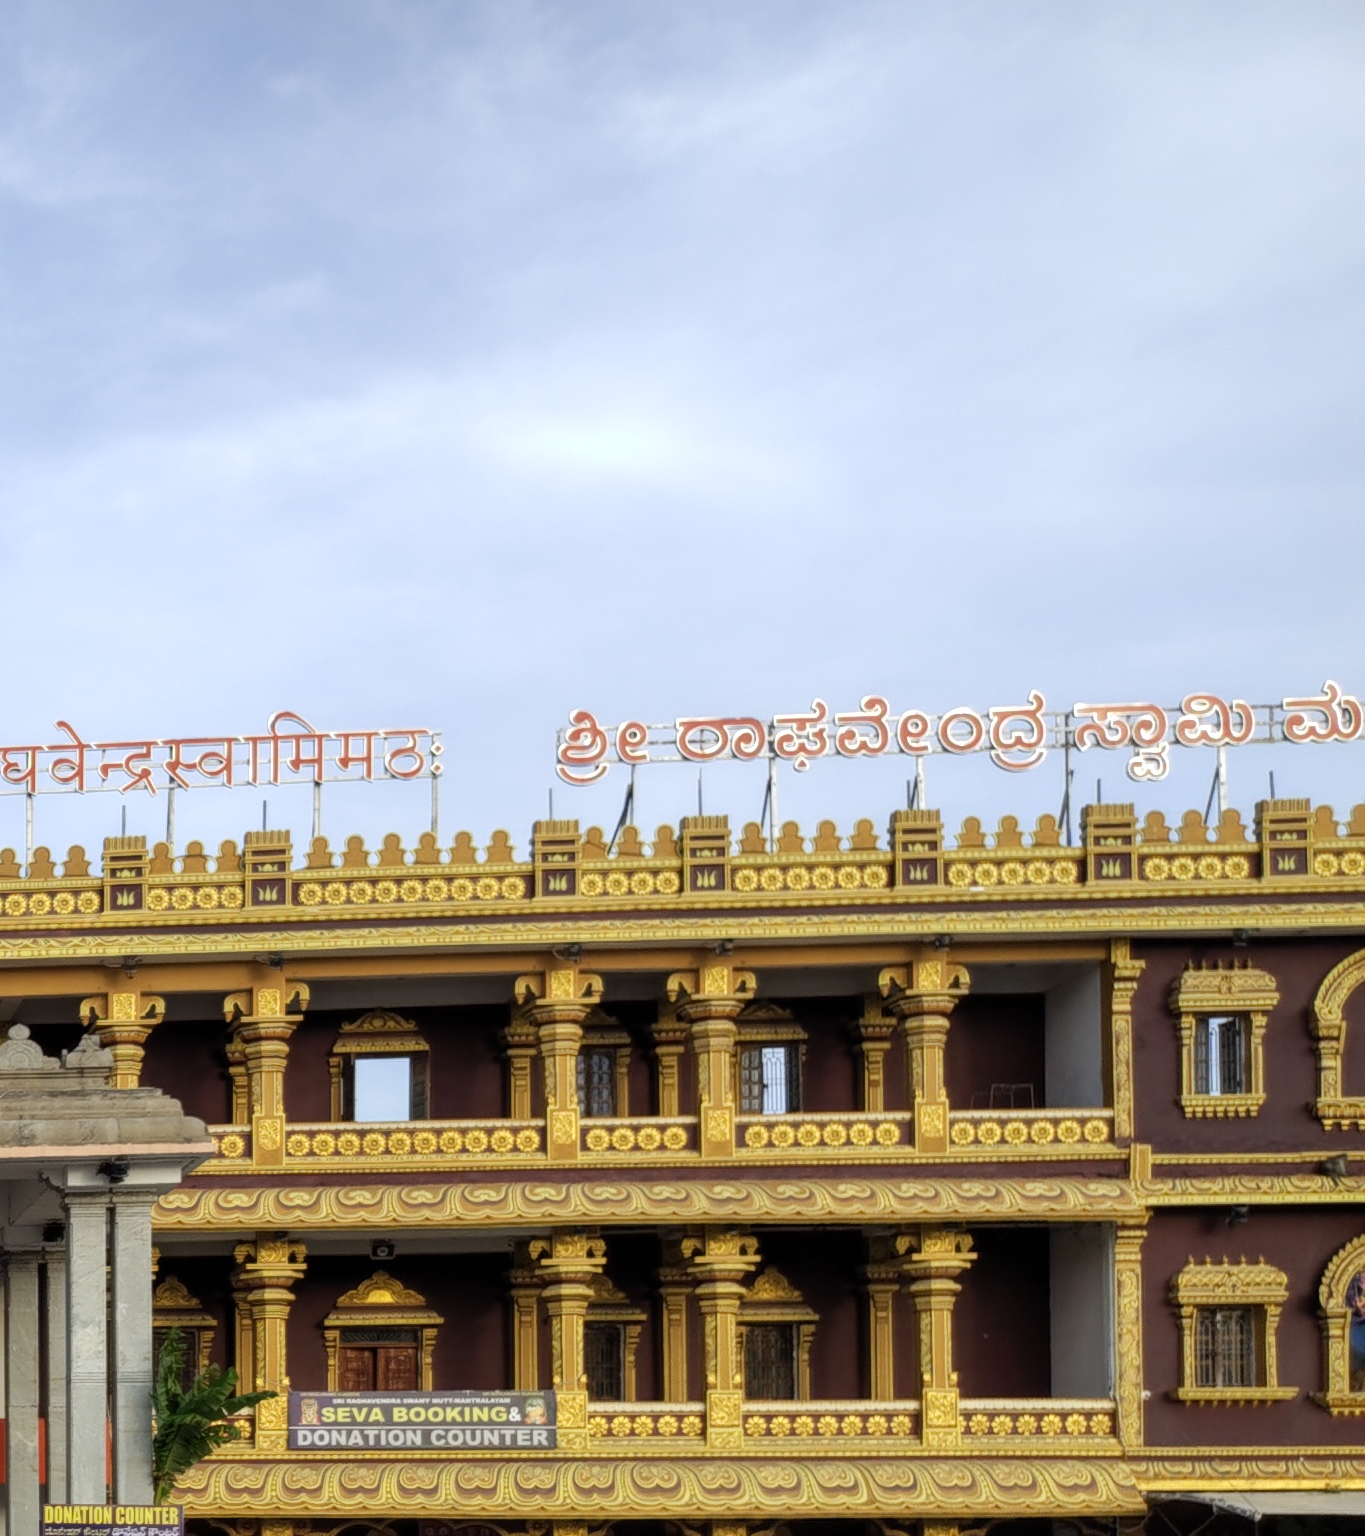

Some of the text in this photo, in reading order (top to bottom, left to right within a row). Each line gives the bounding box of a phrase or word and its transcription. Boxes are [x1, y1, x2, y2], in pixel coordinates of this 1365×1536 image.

[556, 708, 652, 786] ಶ್ರೀ
[1074, 691, 1256, 781] ಸ್ವಾಮಿ
[321, 1406, 385, 1423] SEVA
[297, 1429, 549, 1446] DONATION COUNTER
[44, 1505, 180, 1525] DONATION COUNTER
